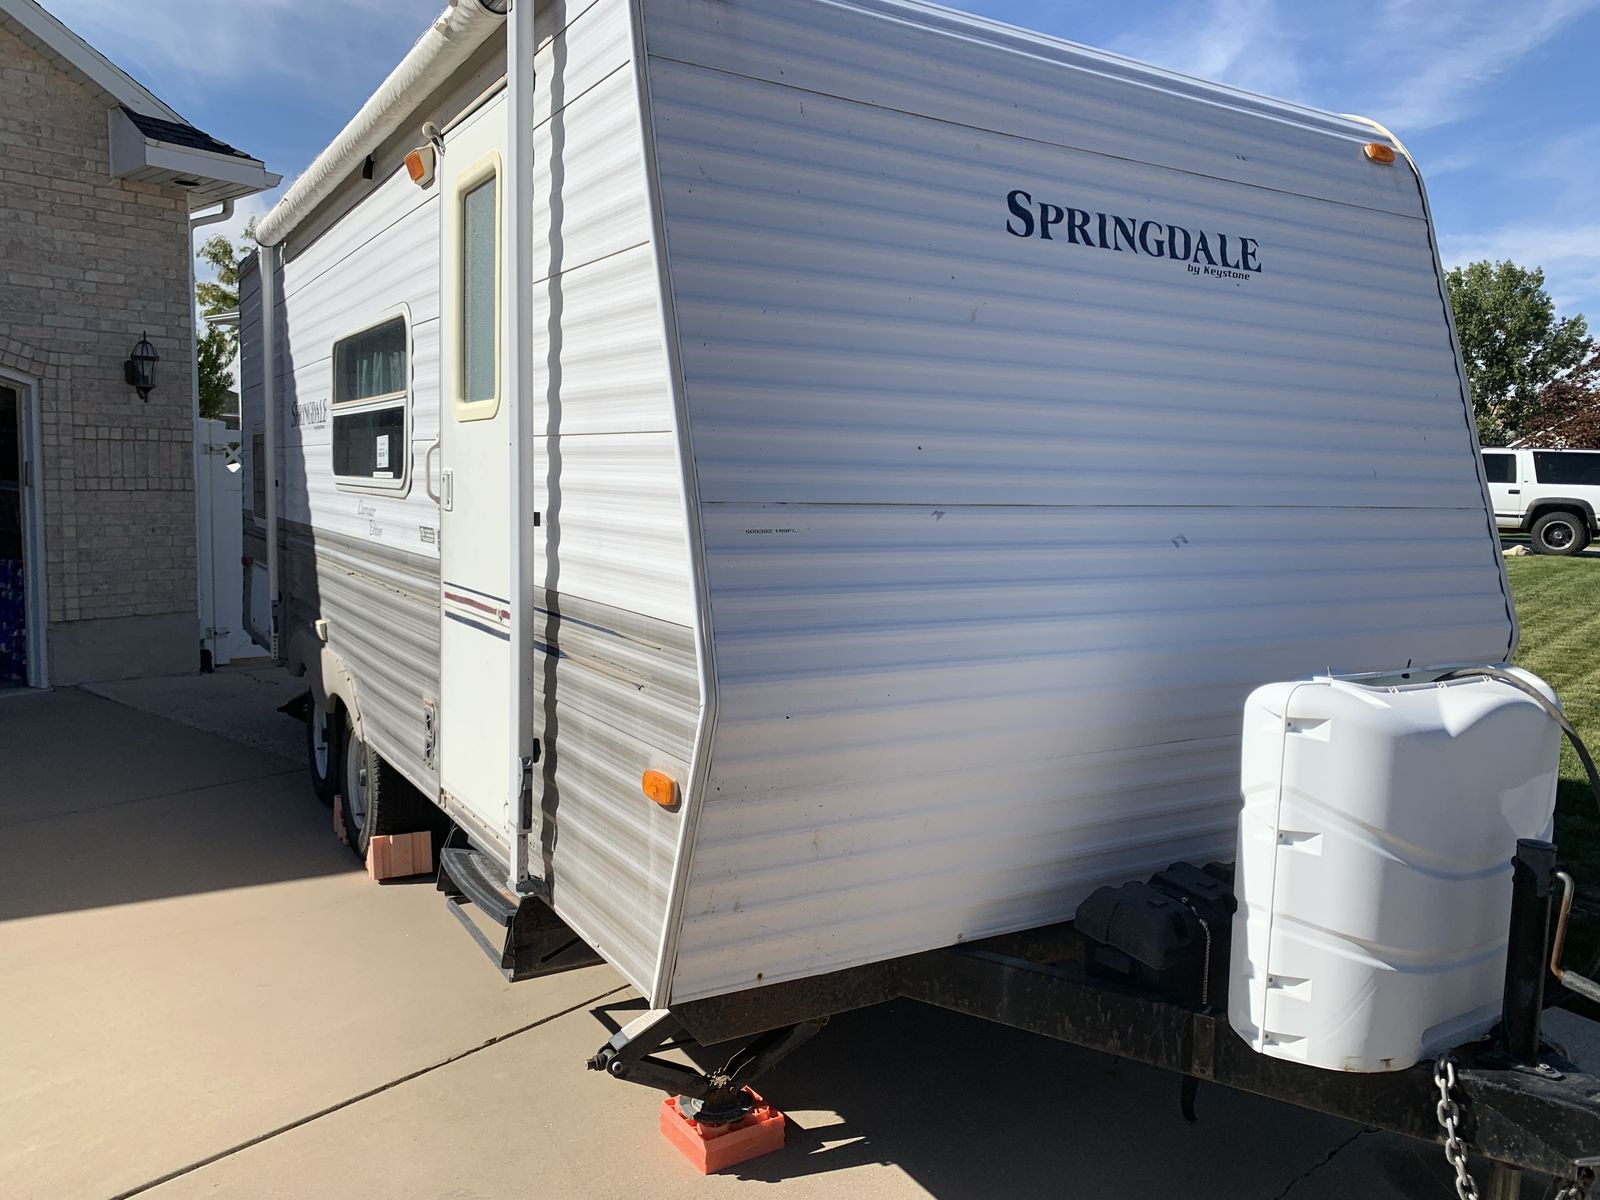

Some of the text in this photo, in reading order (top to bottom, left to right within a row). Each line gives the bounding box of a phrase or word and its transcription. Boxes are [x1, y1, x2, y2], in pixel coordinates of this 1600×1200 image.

[1006, 190, 1262, 273] SPRINGDALE
[1187, 263, 1251, 281] by Keystone
